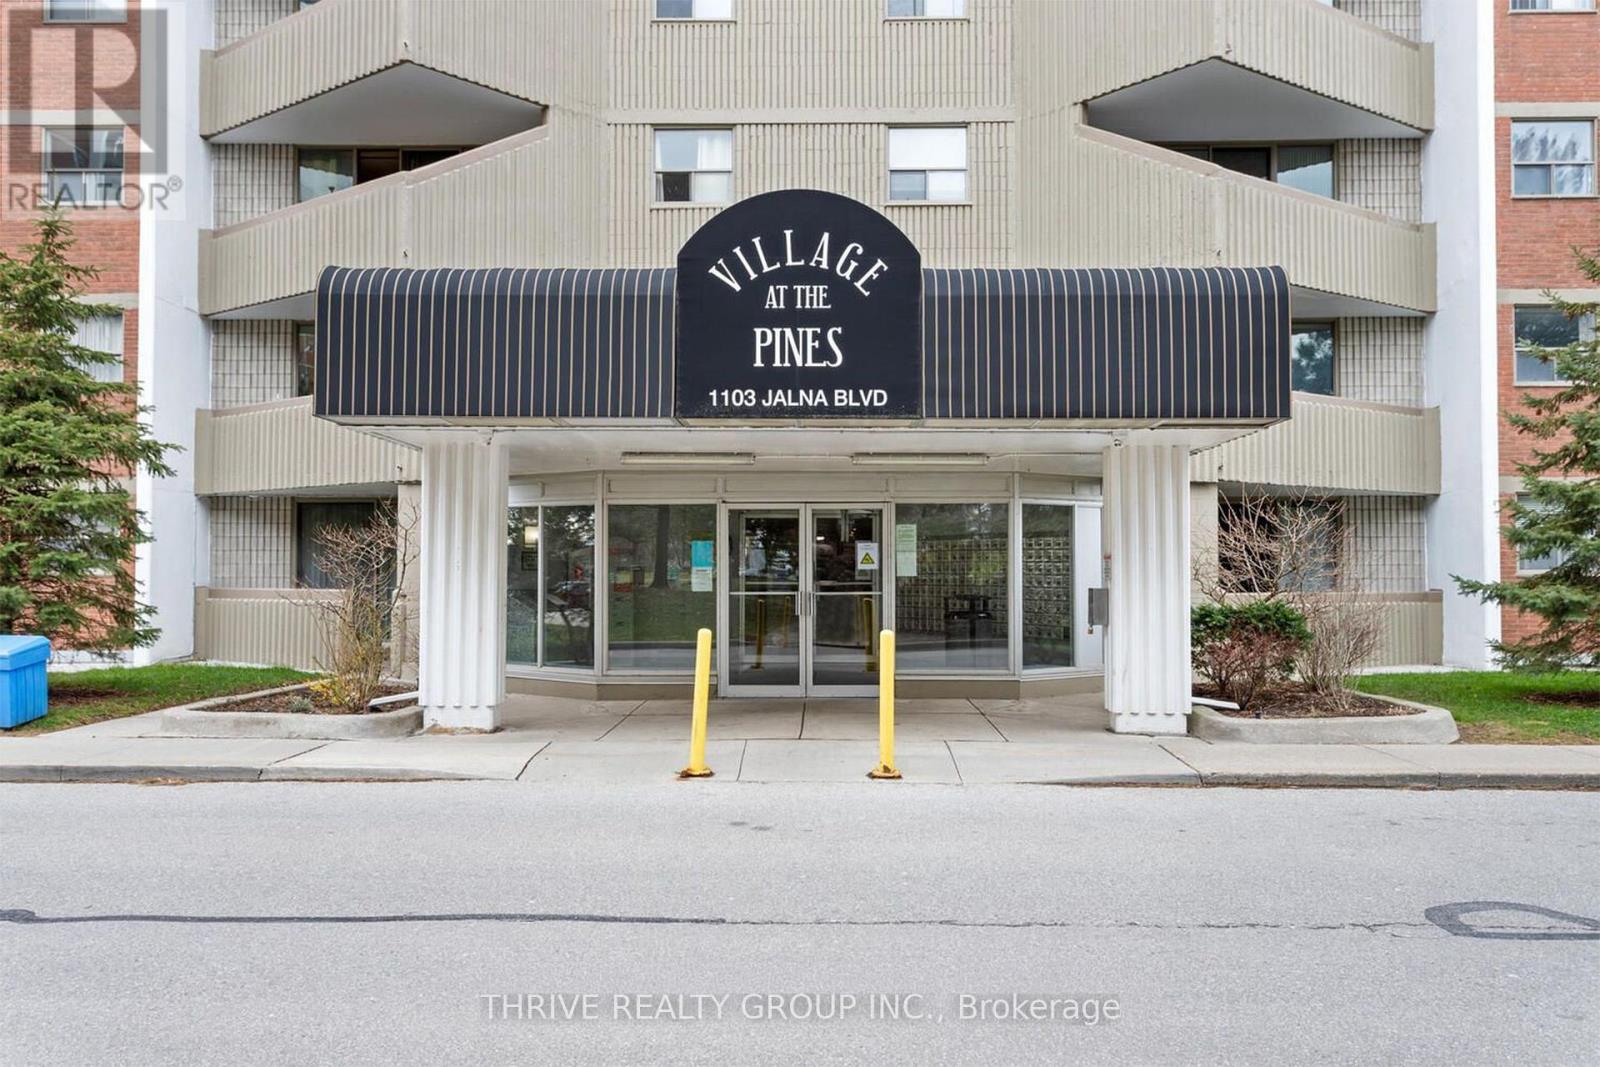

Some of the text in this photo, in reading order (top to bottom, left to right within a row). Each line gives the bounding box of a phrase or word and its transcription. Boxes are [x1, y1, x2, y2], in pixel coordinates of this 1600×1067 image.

[708, 229, 889, 297] VILLAGE
[764, 285, 832, 309] AT THE
[753, 326, 844, 368] PINES
[708, 389, 889, 407] 1103 JALNA BLVD
